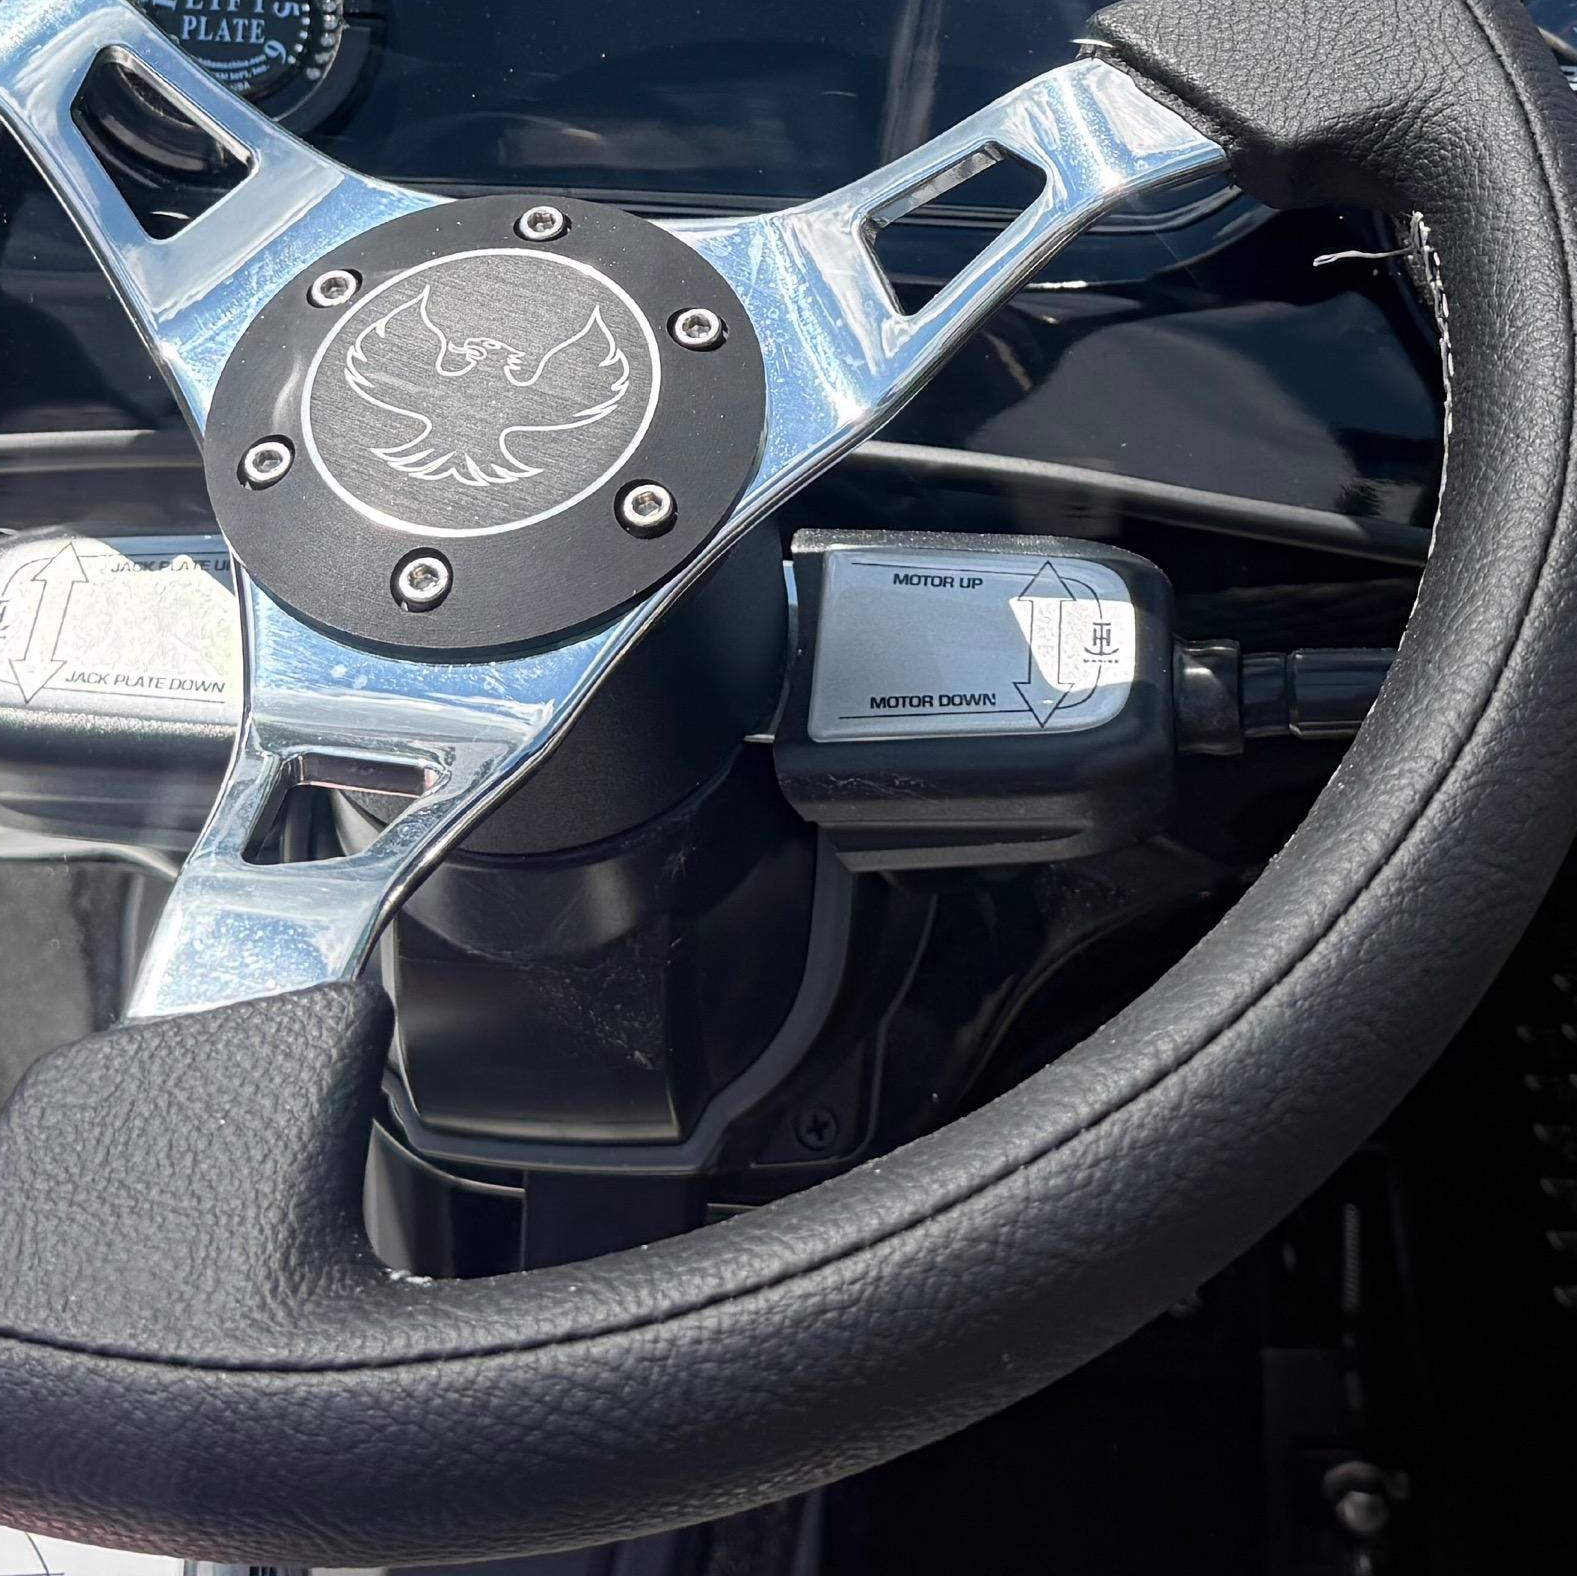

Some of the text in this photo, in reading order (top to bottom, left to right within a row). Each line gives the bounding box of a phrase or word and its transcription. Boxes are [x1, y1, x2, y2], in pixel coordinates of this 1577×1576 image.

[274, 2, 300, 18] 5
[182, 15, 265, 44] PLATE
[264, 40, 287, 65] 6
[111, 561, 156, 573] JACK
[158, 560, 212, 572] PLATE
[893, 573, 983, 589] MOTOR UP
[65, 671, 226, 693] JACK PLATE DOWN
[870, 693, 996, 709] MOTOR DOWN
